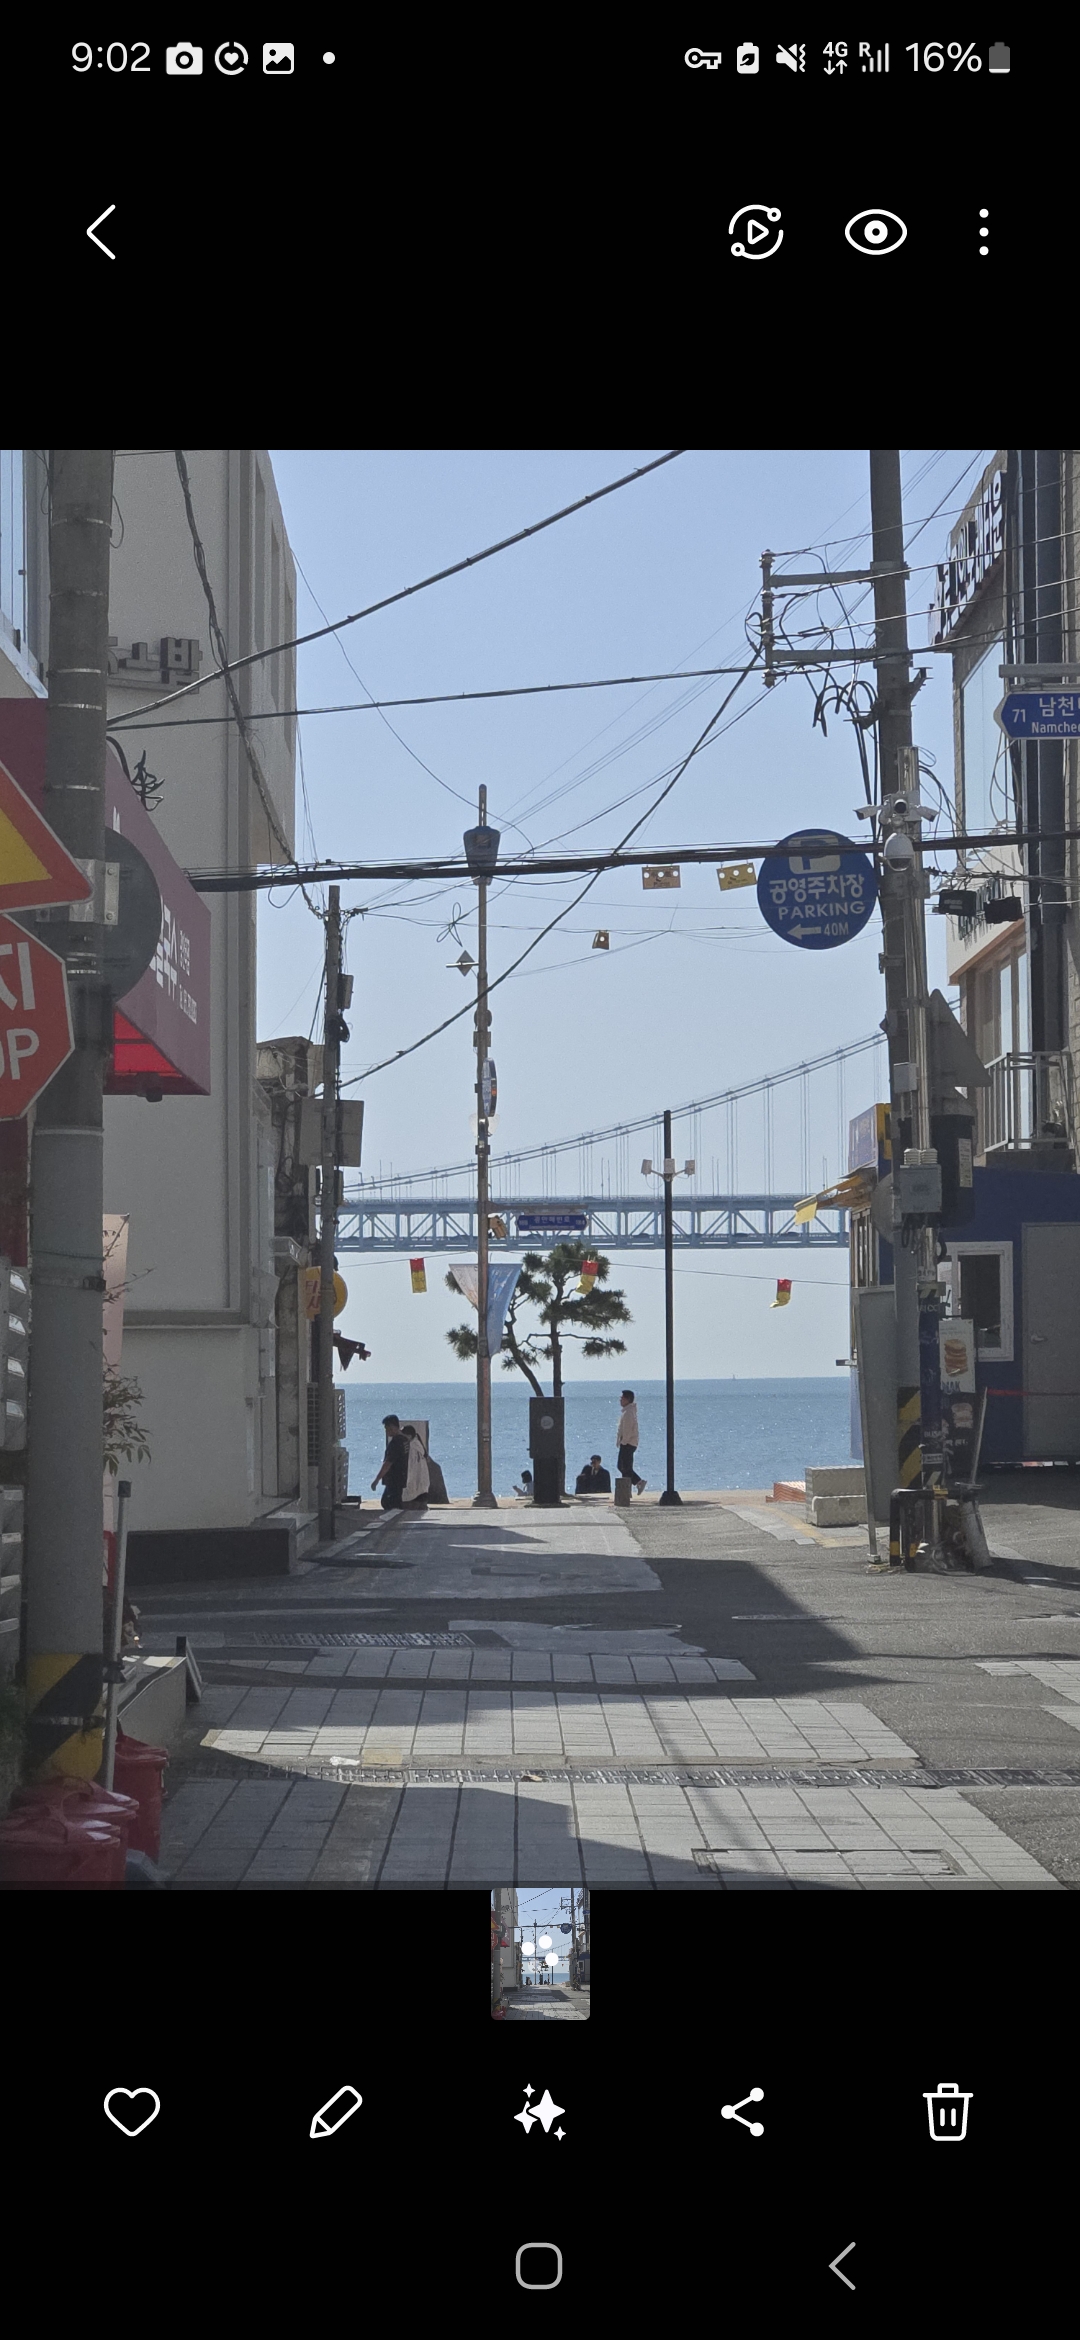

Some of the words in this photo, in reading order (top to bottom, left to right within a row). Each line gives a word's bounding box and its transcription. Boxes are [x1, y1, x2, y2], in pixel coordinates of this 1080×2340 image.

[72, 42, 150, 72] 9:02
[823, 41, 848, 57] 4G
[905, 42, 982, 72] 16%
[1011, 708, 1026, 723] 71
[1038, 696, 1080, 717] 남천
[768, 873, 865, 905] 공영주차장
[778, 900, 866, 921] PARKING
[824, 921, 849, 937] 40M
[0, 1028, 40, 1081] P
